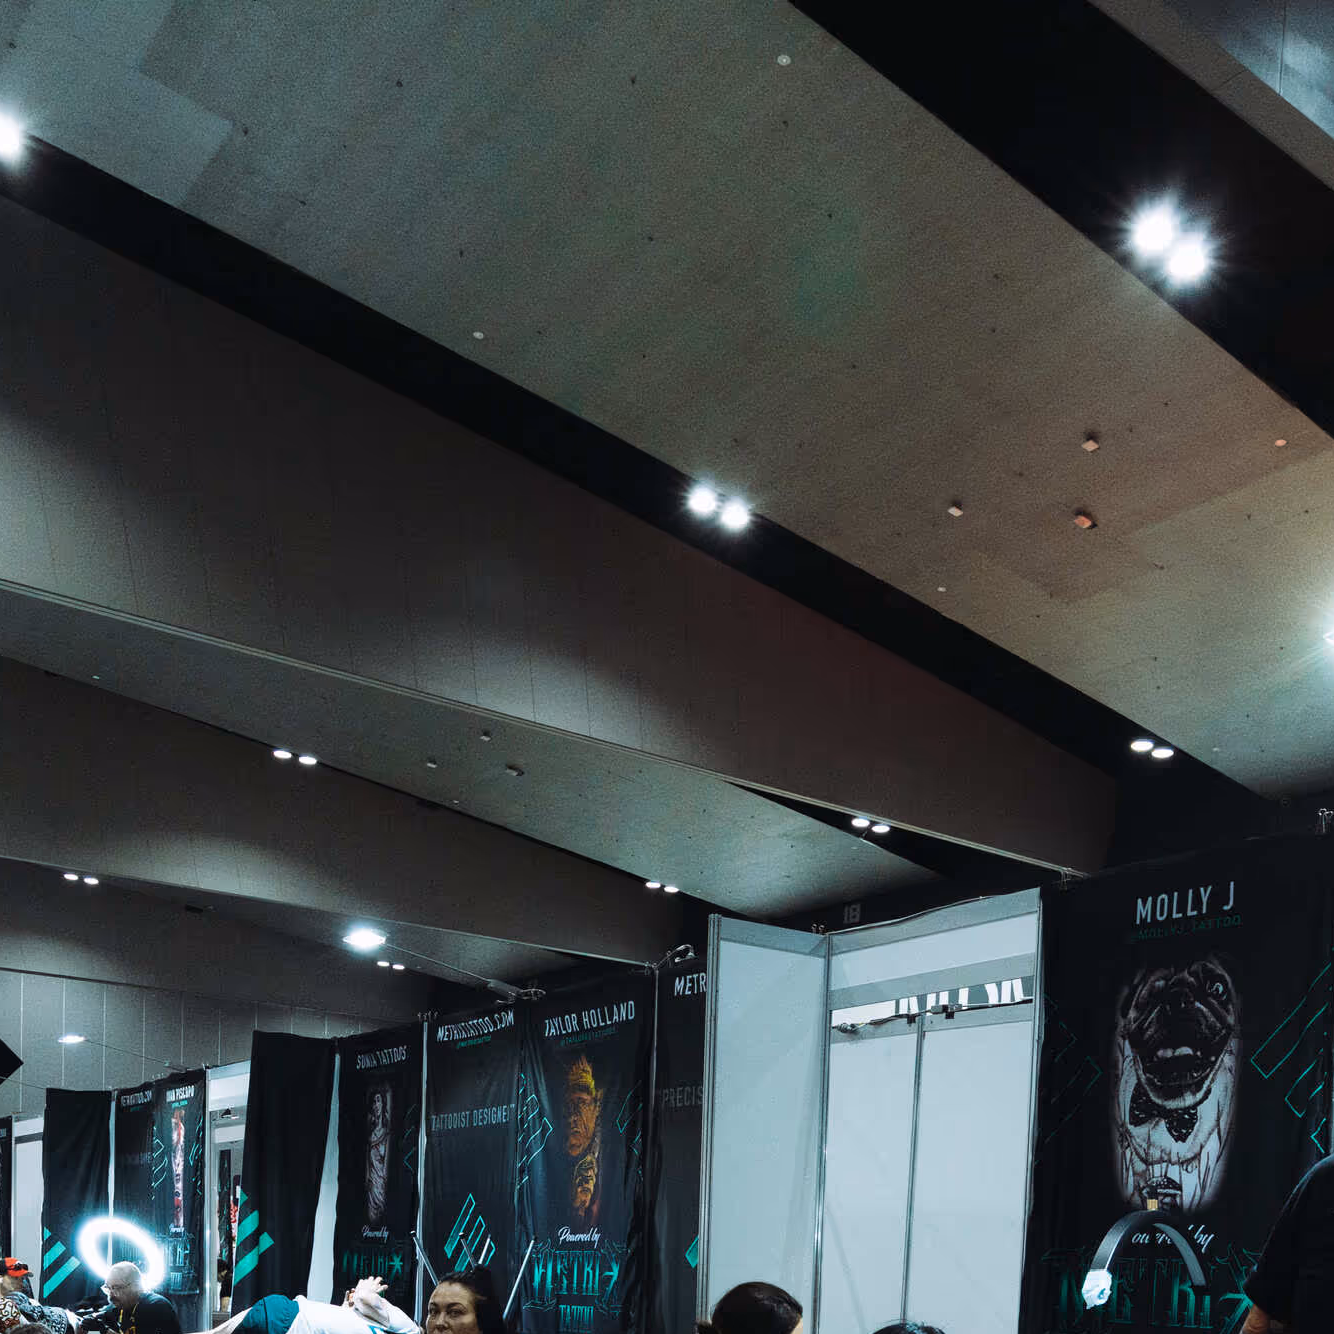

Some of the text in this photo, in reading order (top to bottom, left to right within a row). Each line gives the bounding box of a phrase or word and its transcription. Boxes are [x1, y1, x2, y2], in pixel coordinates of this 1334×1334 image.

[842, 903, 862, 924] 18
[1135, 880, 1236, 925] MOLLY J
[674, 968, 706, 997] METR
[436, 1009, 515, 1043] METRIXTATTOO.COM
[544, 1010, 580, 1038] TAYLOR
[582, 1000, 636, 1028] HOLLAND
[431, 1108, 470, 1132] TATTOOIST
[361, 1224, 390, 1243] Powered by
[557, 1225, 603, 1248] Powered by
